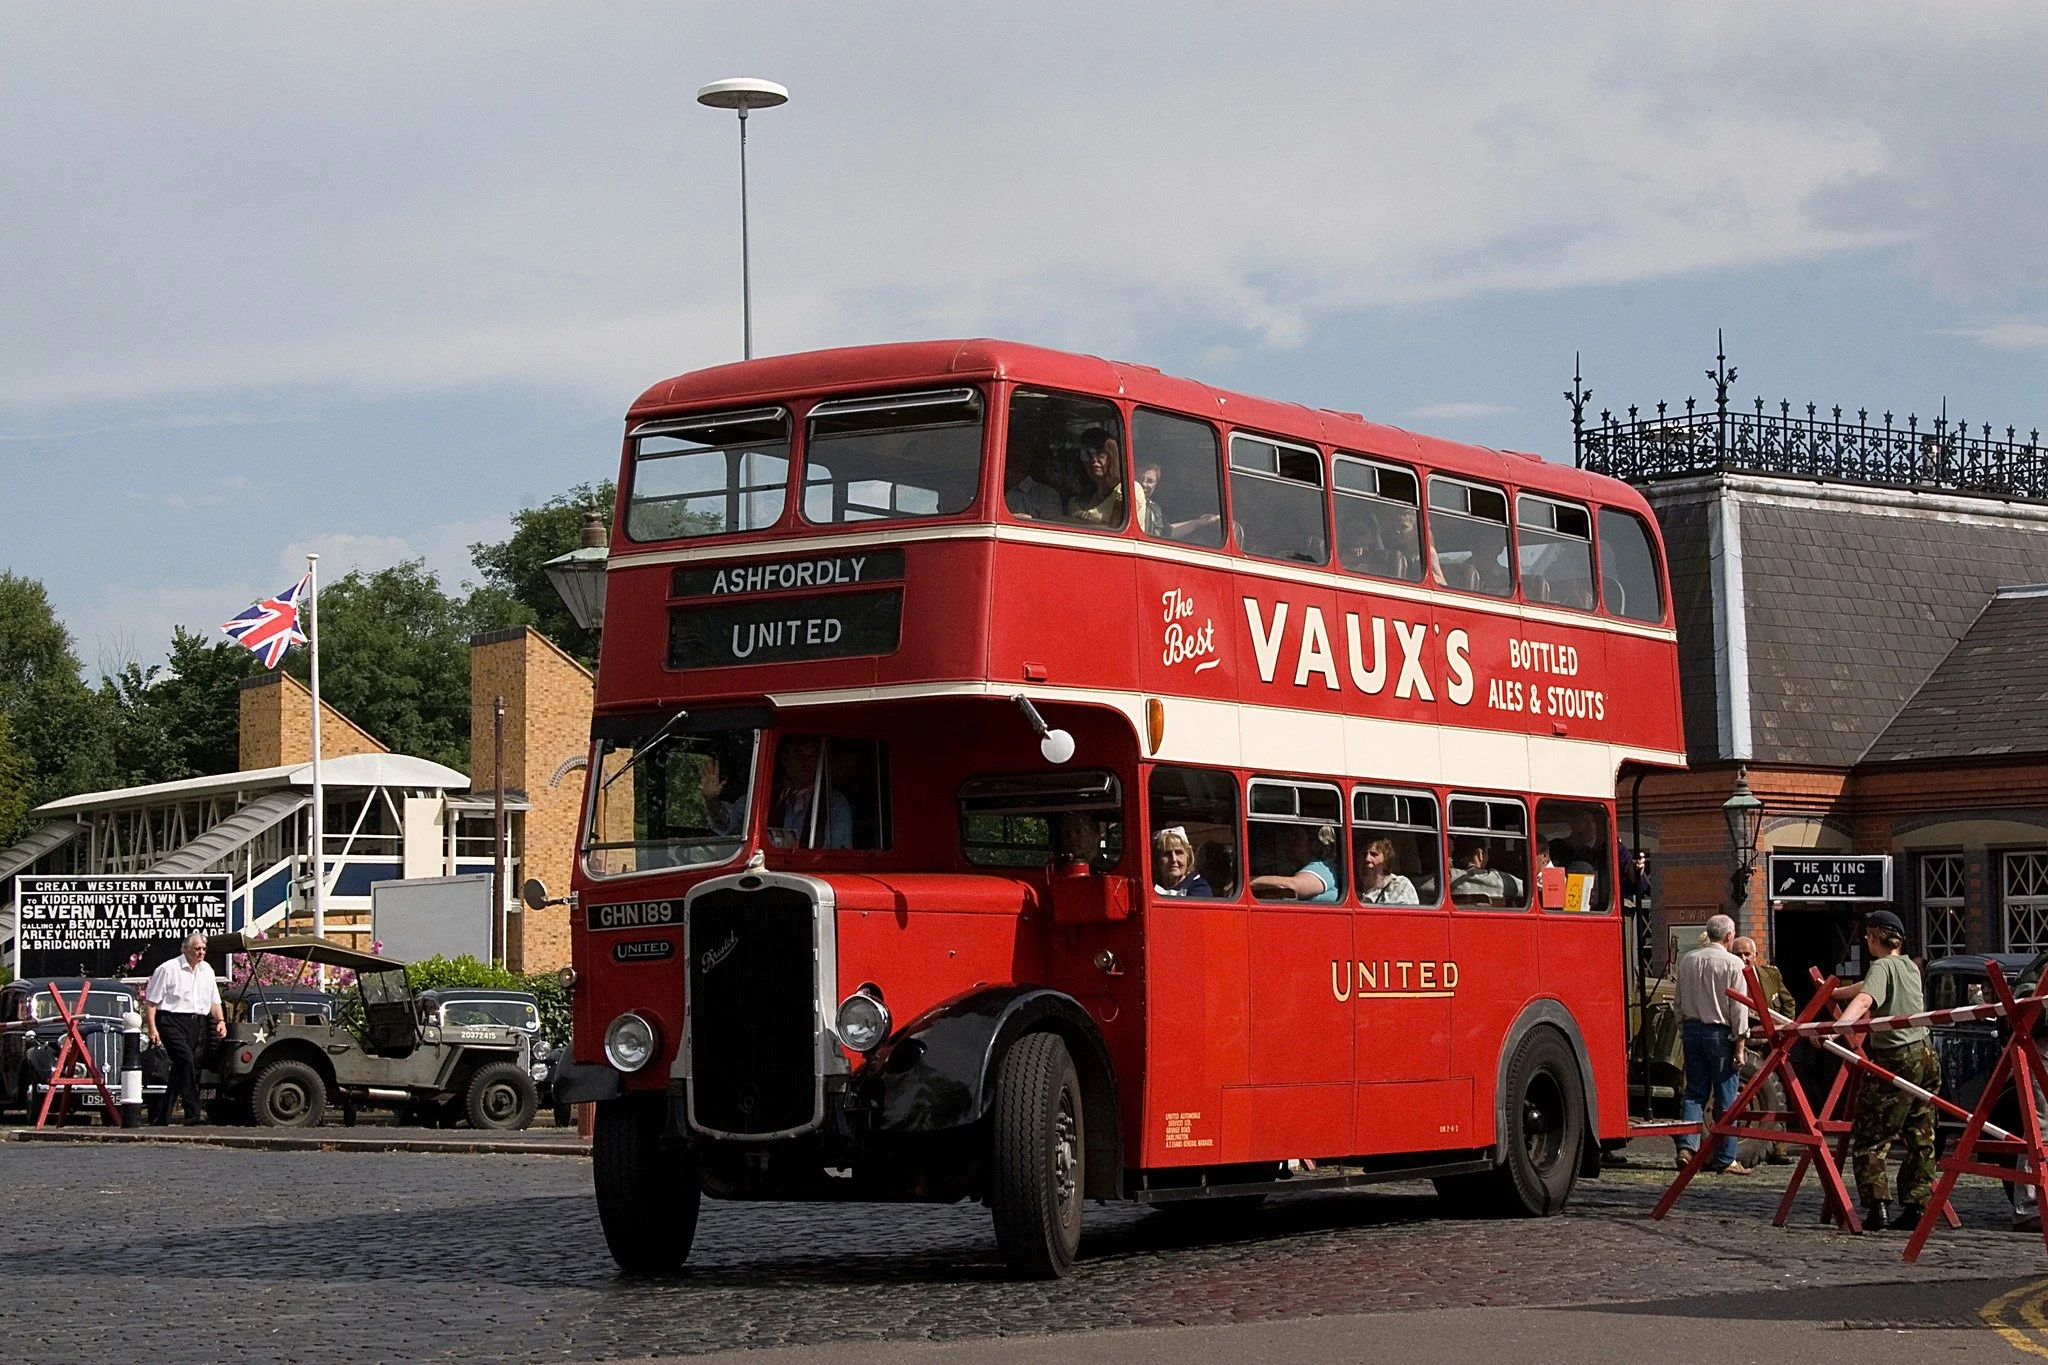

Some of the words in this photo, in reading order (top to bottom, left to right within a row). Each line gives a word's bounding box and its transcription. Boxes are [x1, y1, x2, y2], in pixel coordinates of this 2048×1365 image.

[712, 557, 866, 594] ASHFORDLY
[1162, 588, 1193, 622] The
[732, 618, 841, 657] UNITED
[1163, 618, 1214, 666] Best
[1242, 597, 1475, 705] VAUX'S
[1510, 638, 1578, 675] BOTTLED
[1488, 678, 1523, 711] ALES
[1530, 684, 1541, 714] &
[1547, 686, 1604, 720] STOUTS
[1794, 862, 1819, 873] THE
[1833, 863, 1865, 873] KING
[1817, 874, 1840, 882] AND
[36, 882, 77, 891] GREAT
[88, 881, 146, 891] WESTERN
[155, 881, 211, 890] RAILWAY
[1803, 884, 1856, 894] CASTLE
[42, 895, 137, 904] KIDDERMINSTER
[142, 894, 175, 903] TOWN
[22, 905, 95, 919] SEVERN
[104, 905, 177, 918] VALLEY
[184, 904, 225, 917] LINE
[69, 919, 127, 929] BEWDLEY
[131, 919, 204, 928] NORTHWOOD
[22, 930, 61, 939] ARLEY
[65, 929, 116, 939] HIGHLEY
[121, 929, 180, 939] HAMPTON
[22, 940, 31, 949] &
[34, 940, 110, 949] BRIDGNORTH
[617, 943, 669, 959] UNITED
[1331, 961, 1459, 1002] UNITED
